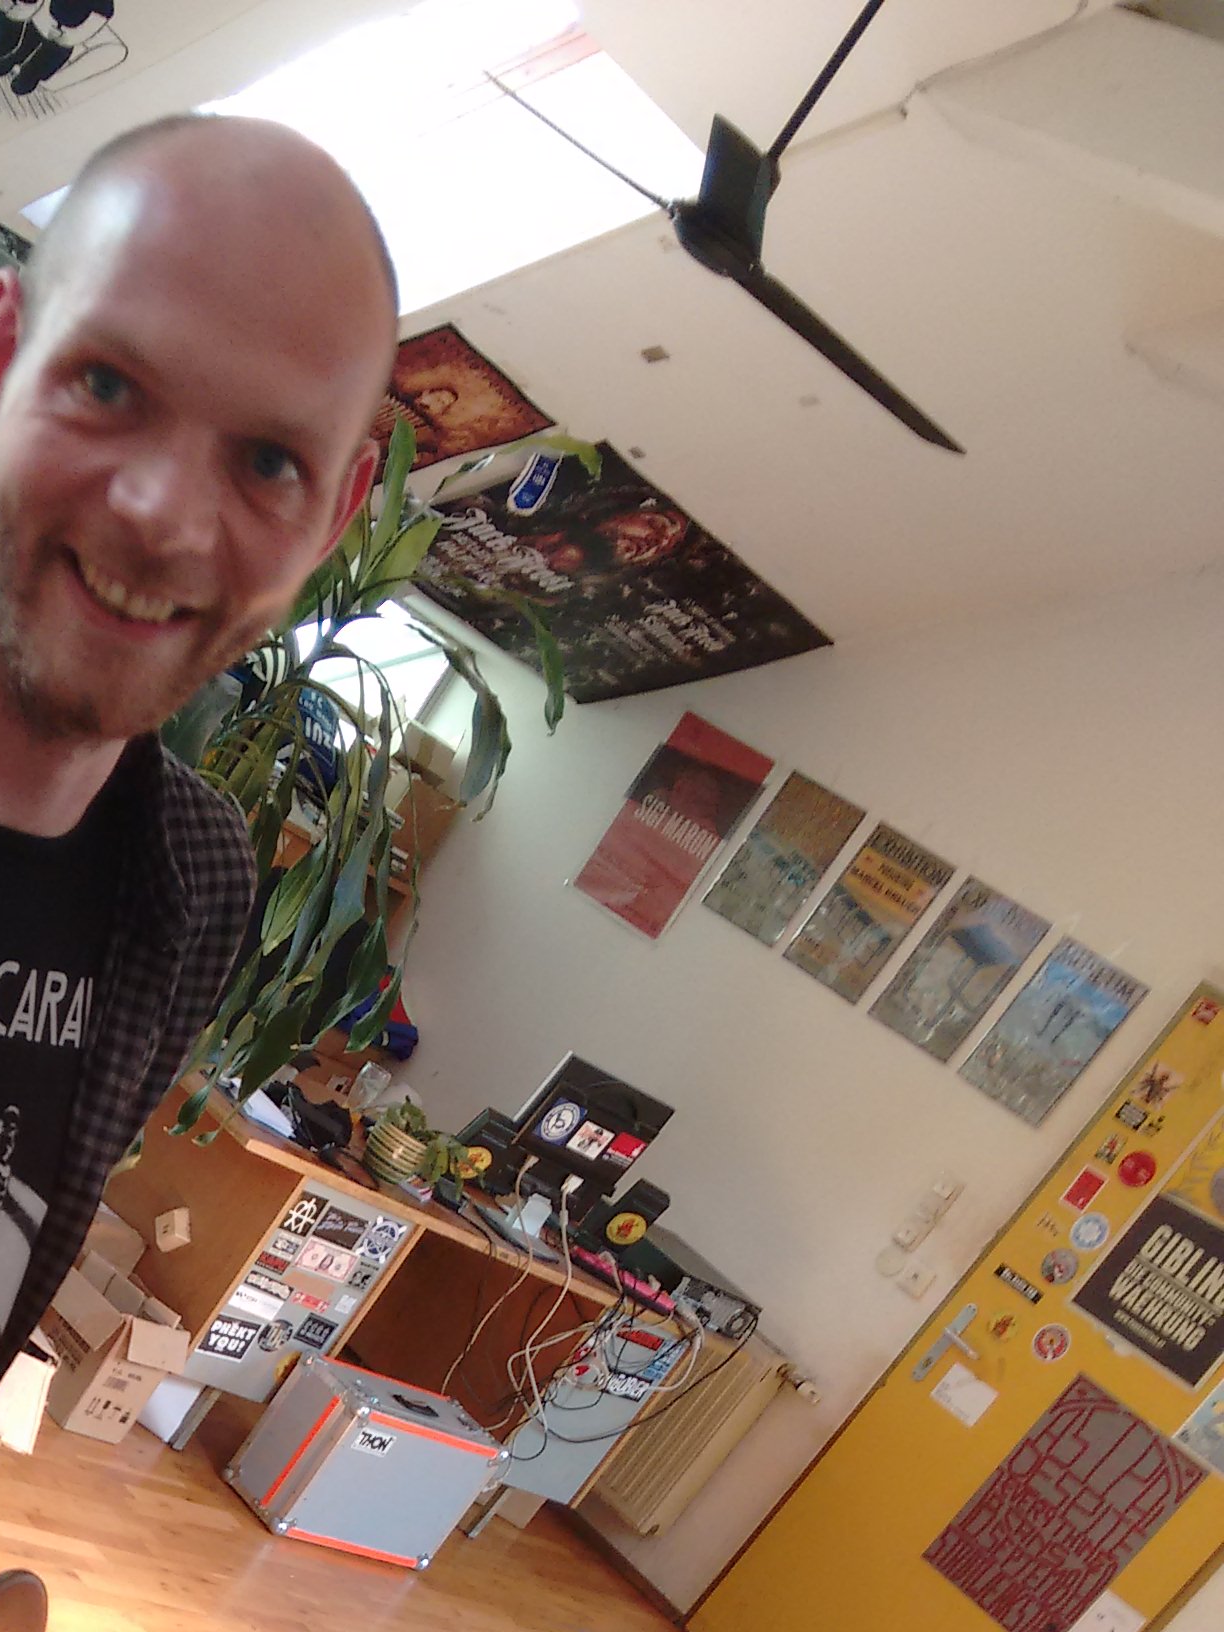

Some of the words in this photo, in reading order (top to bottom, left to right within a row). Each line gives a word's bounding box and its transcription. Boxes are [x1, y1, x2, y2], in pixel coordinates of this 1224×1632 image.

[634, 794, 671, 829] SIGI
[661, 812, 718, 860] MARON
[1108, 1271, 1206, 1352] WAEHRUNG
[208, 1334, 246, 1352] YOU!
[359, 1431, 393, 1452] THON
